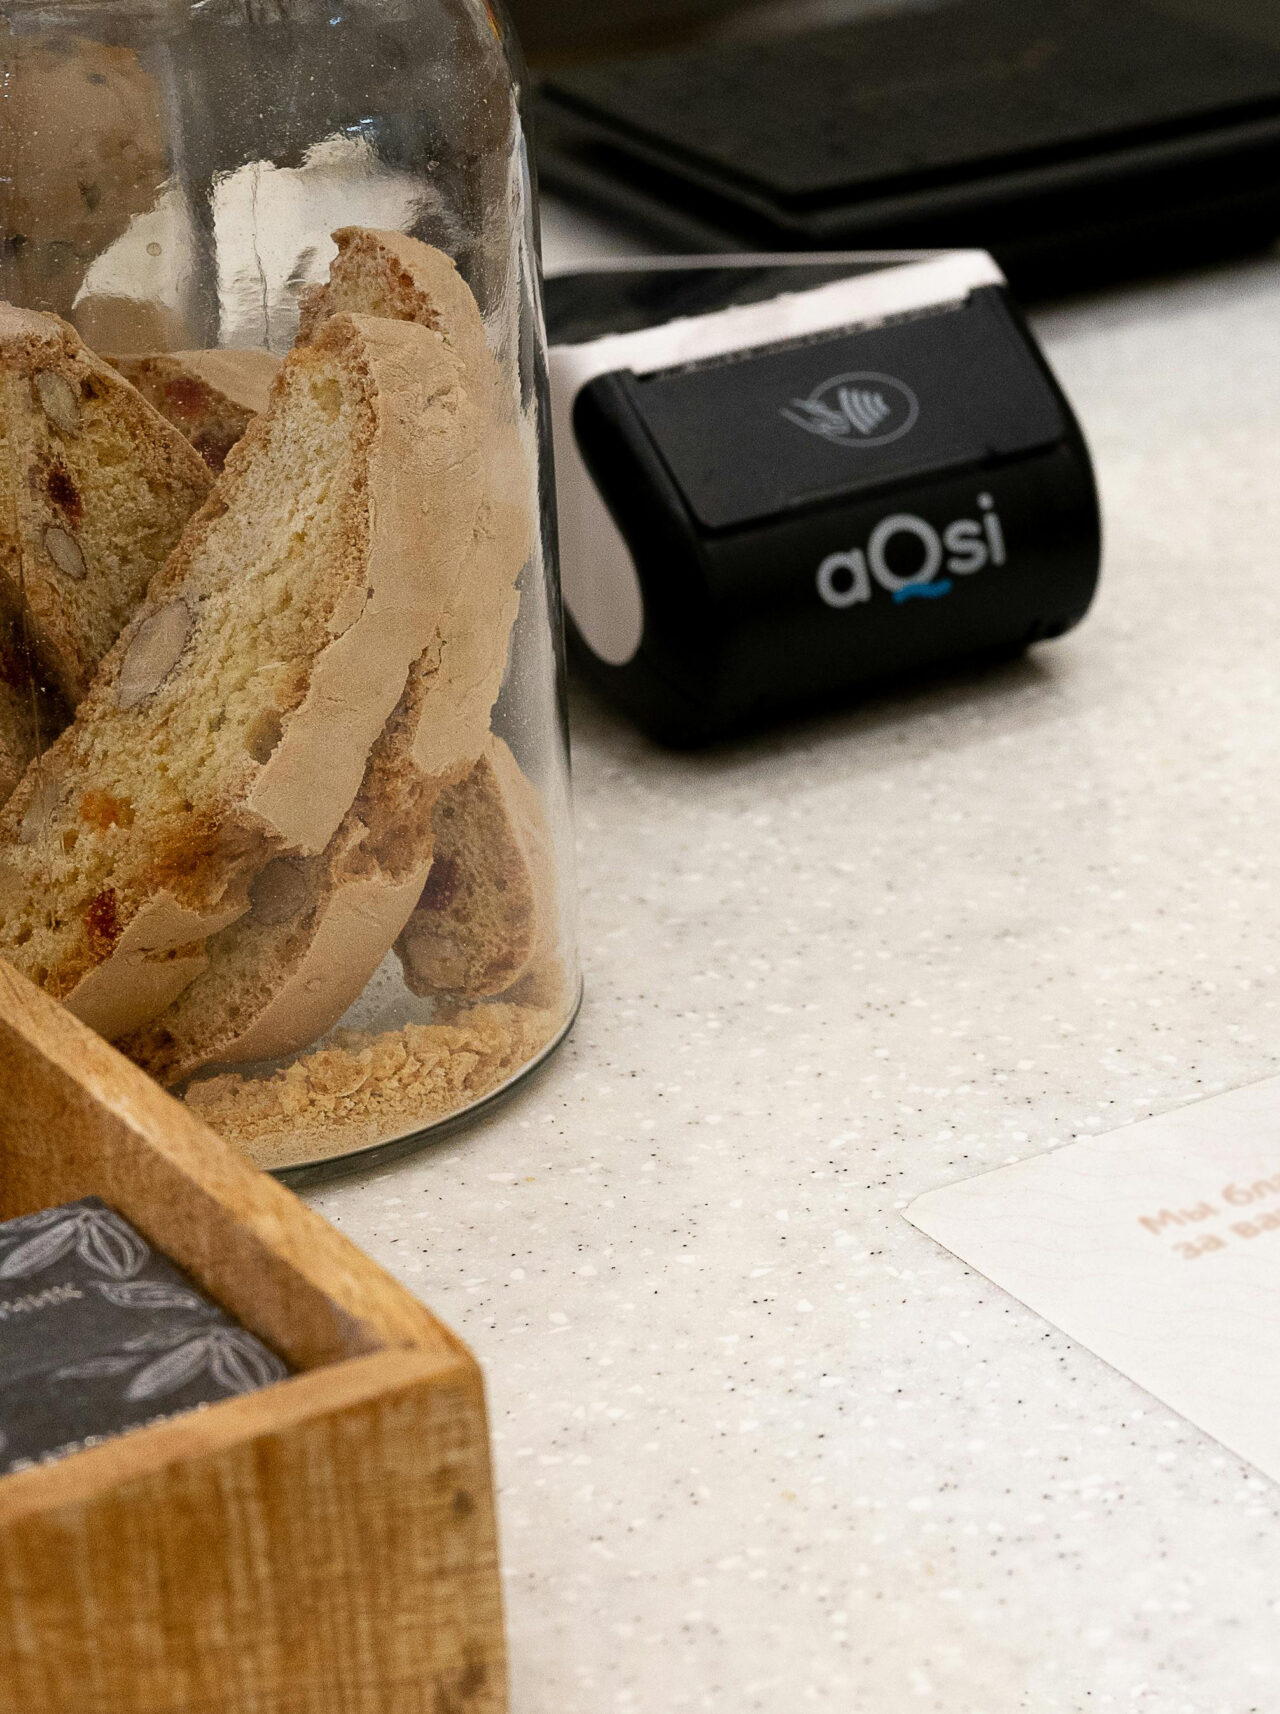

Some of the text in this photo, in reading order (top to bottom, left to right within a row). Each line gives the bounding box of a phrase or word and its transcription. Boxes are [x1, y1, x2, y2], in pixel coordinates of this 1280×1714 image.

[816, 492, 1006, 608] aQsi
[1137, 1201, 1220, 1236] Мы
[1171, 1234, 1228, 1260] за
